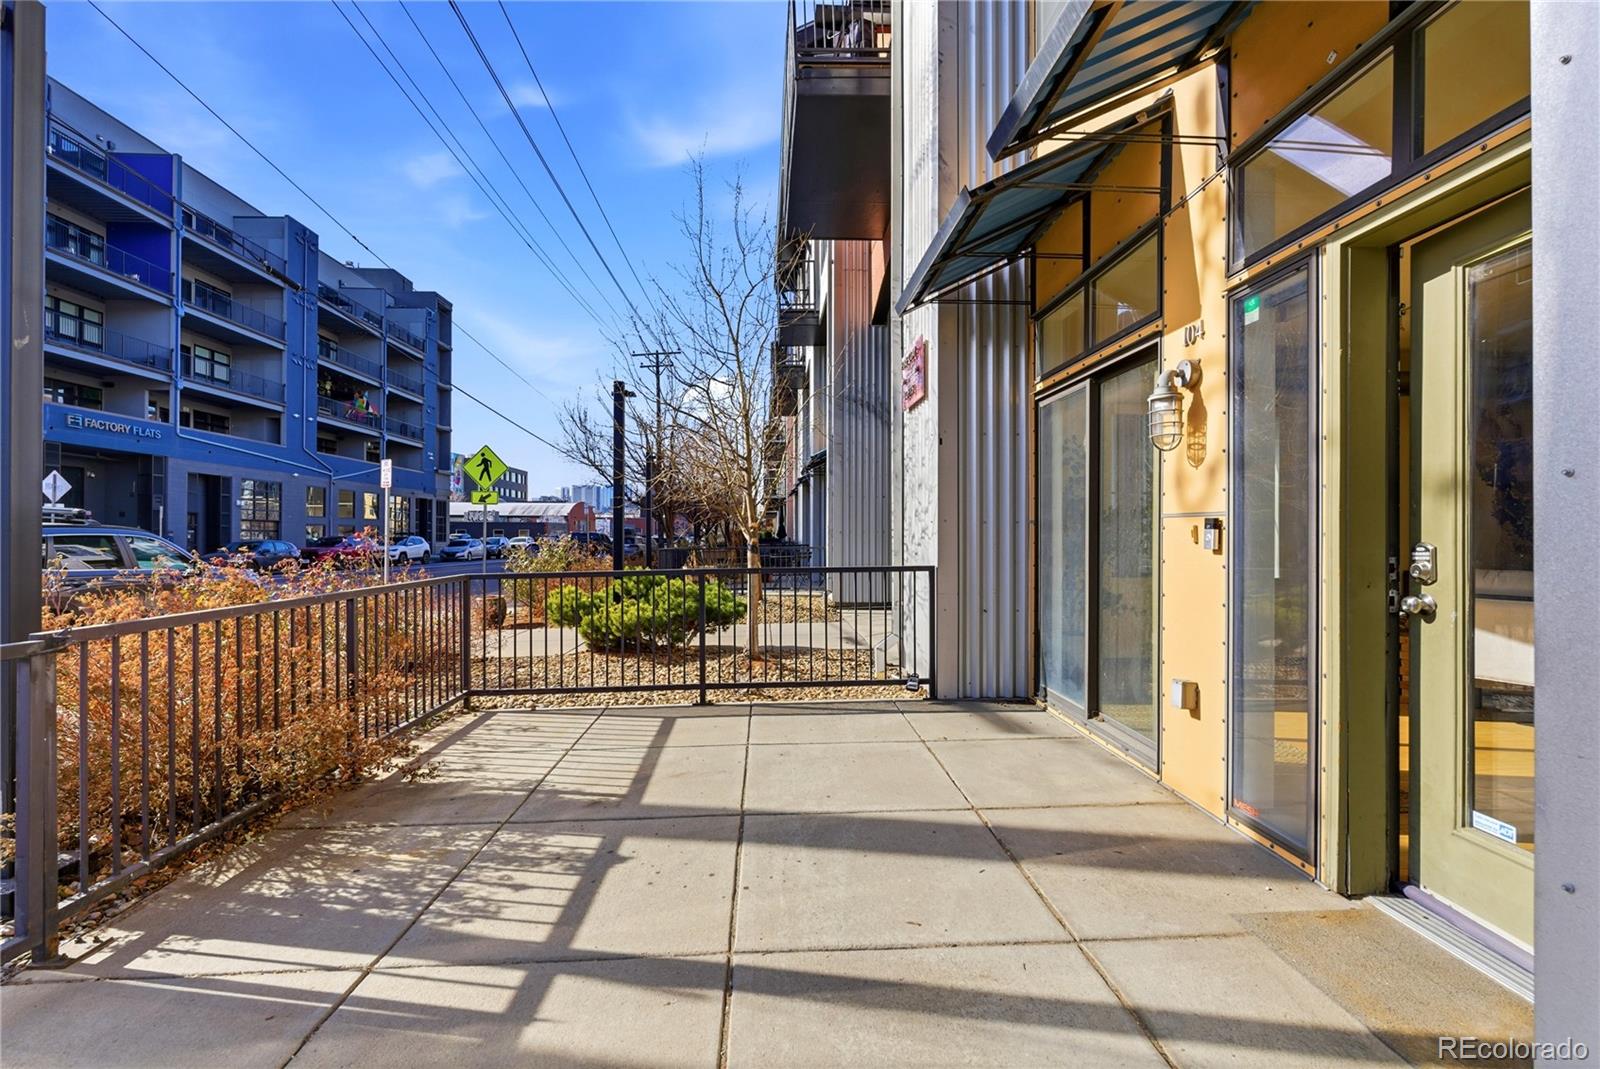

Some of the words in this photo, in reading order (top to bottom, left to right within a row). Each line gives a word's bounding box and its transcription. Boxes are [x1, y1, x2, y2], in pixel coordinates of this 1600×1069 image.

[1184, 319, 1206, 348] 104
[85, 418, 131, 434] FACTORY
[133, 427, 162, 439] FLATS
